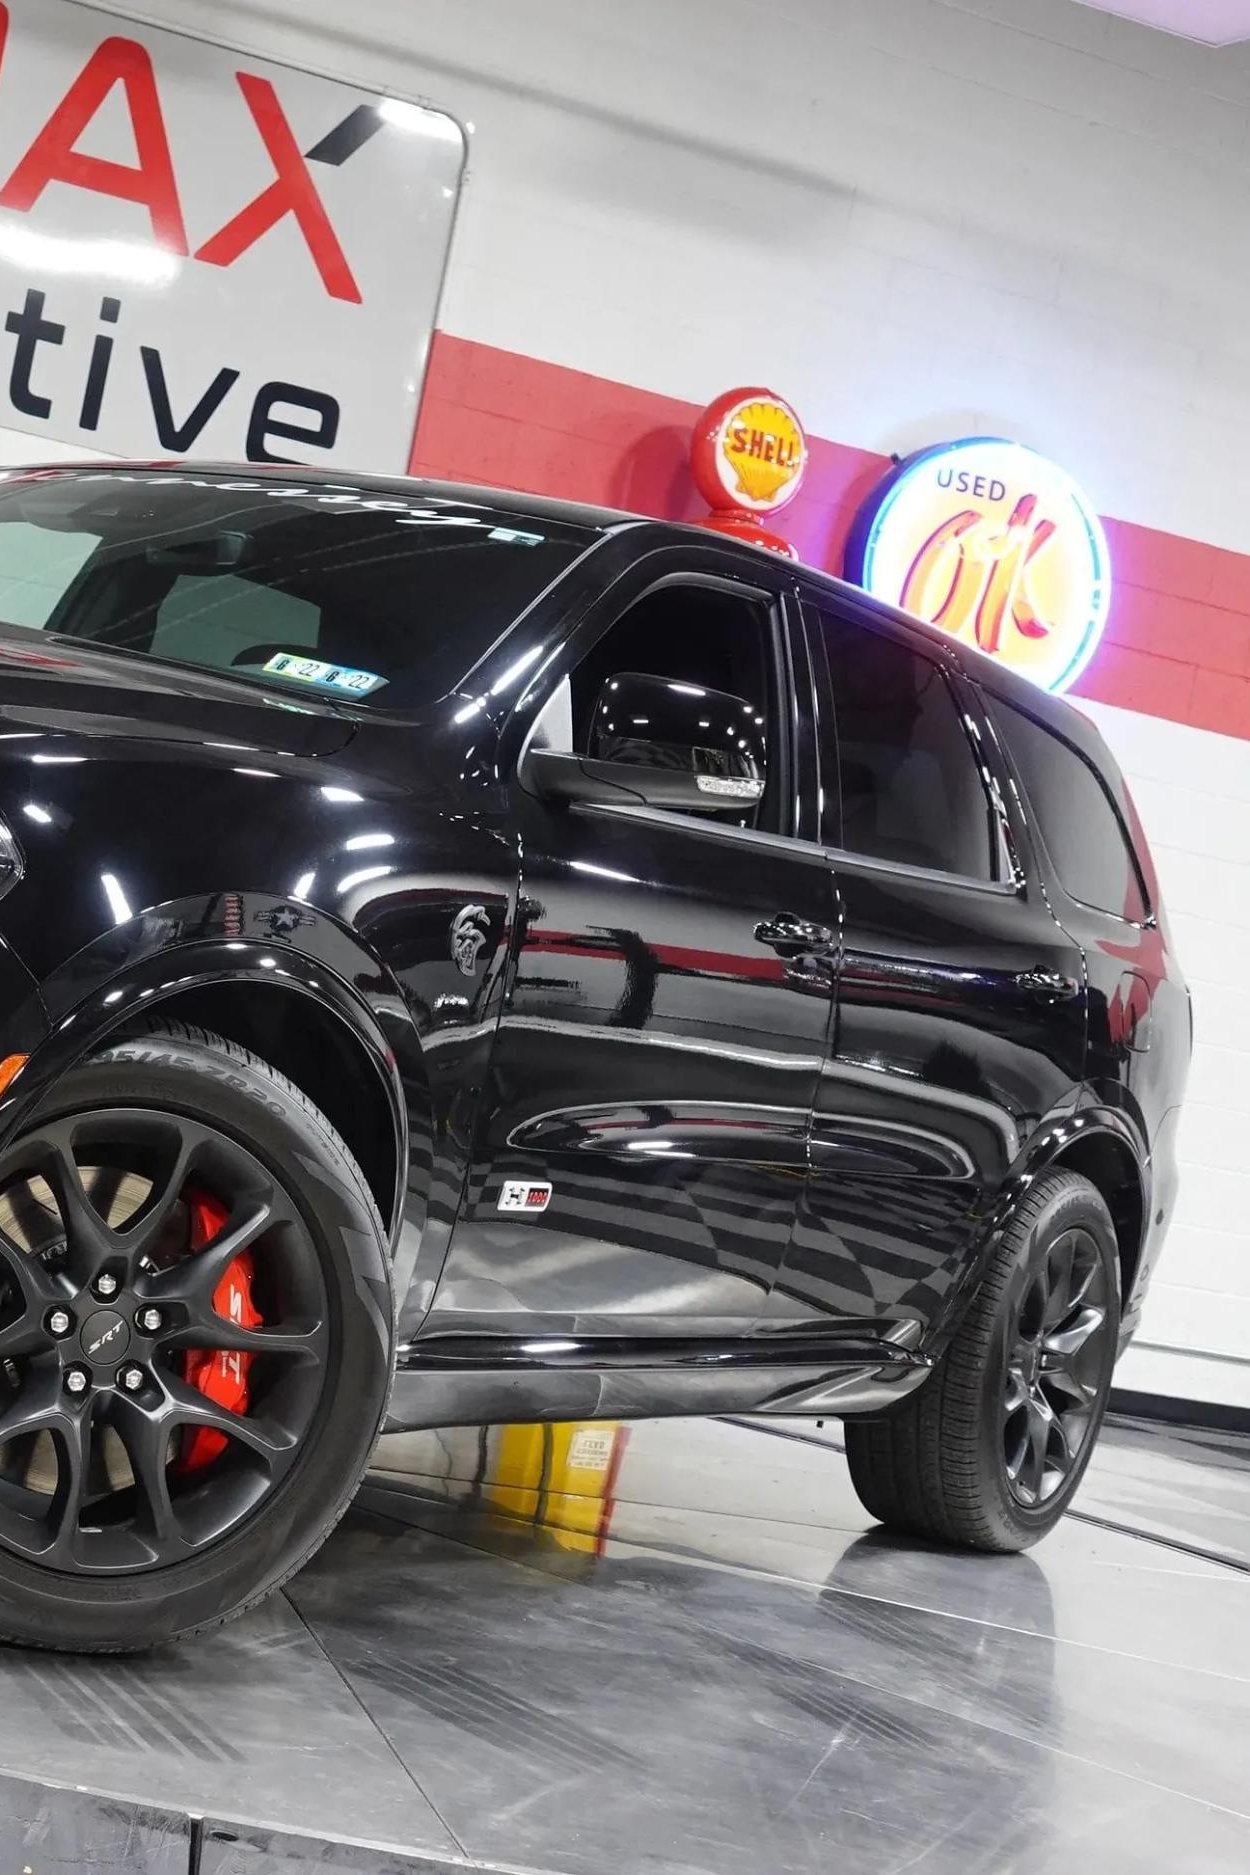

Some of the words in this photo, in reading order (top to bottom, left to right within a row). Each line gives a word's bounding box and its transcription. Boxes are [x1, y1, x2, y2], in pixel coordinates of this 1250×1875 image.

[731, 427, 795, 468] SHELL
[936, 467, 1007, 502] USED
[88, 1319, 124, 1355] SRT
